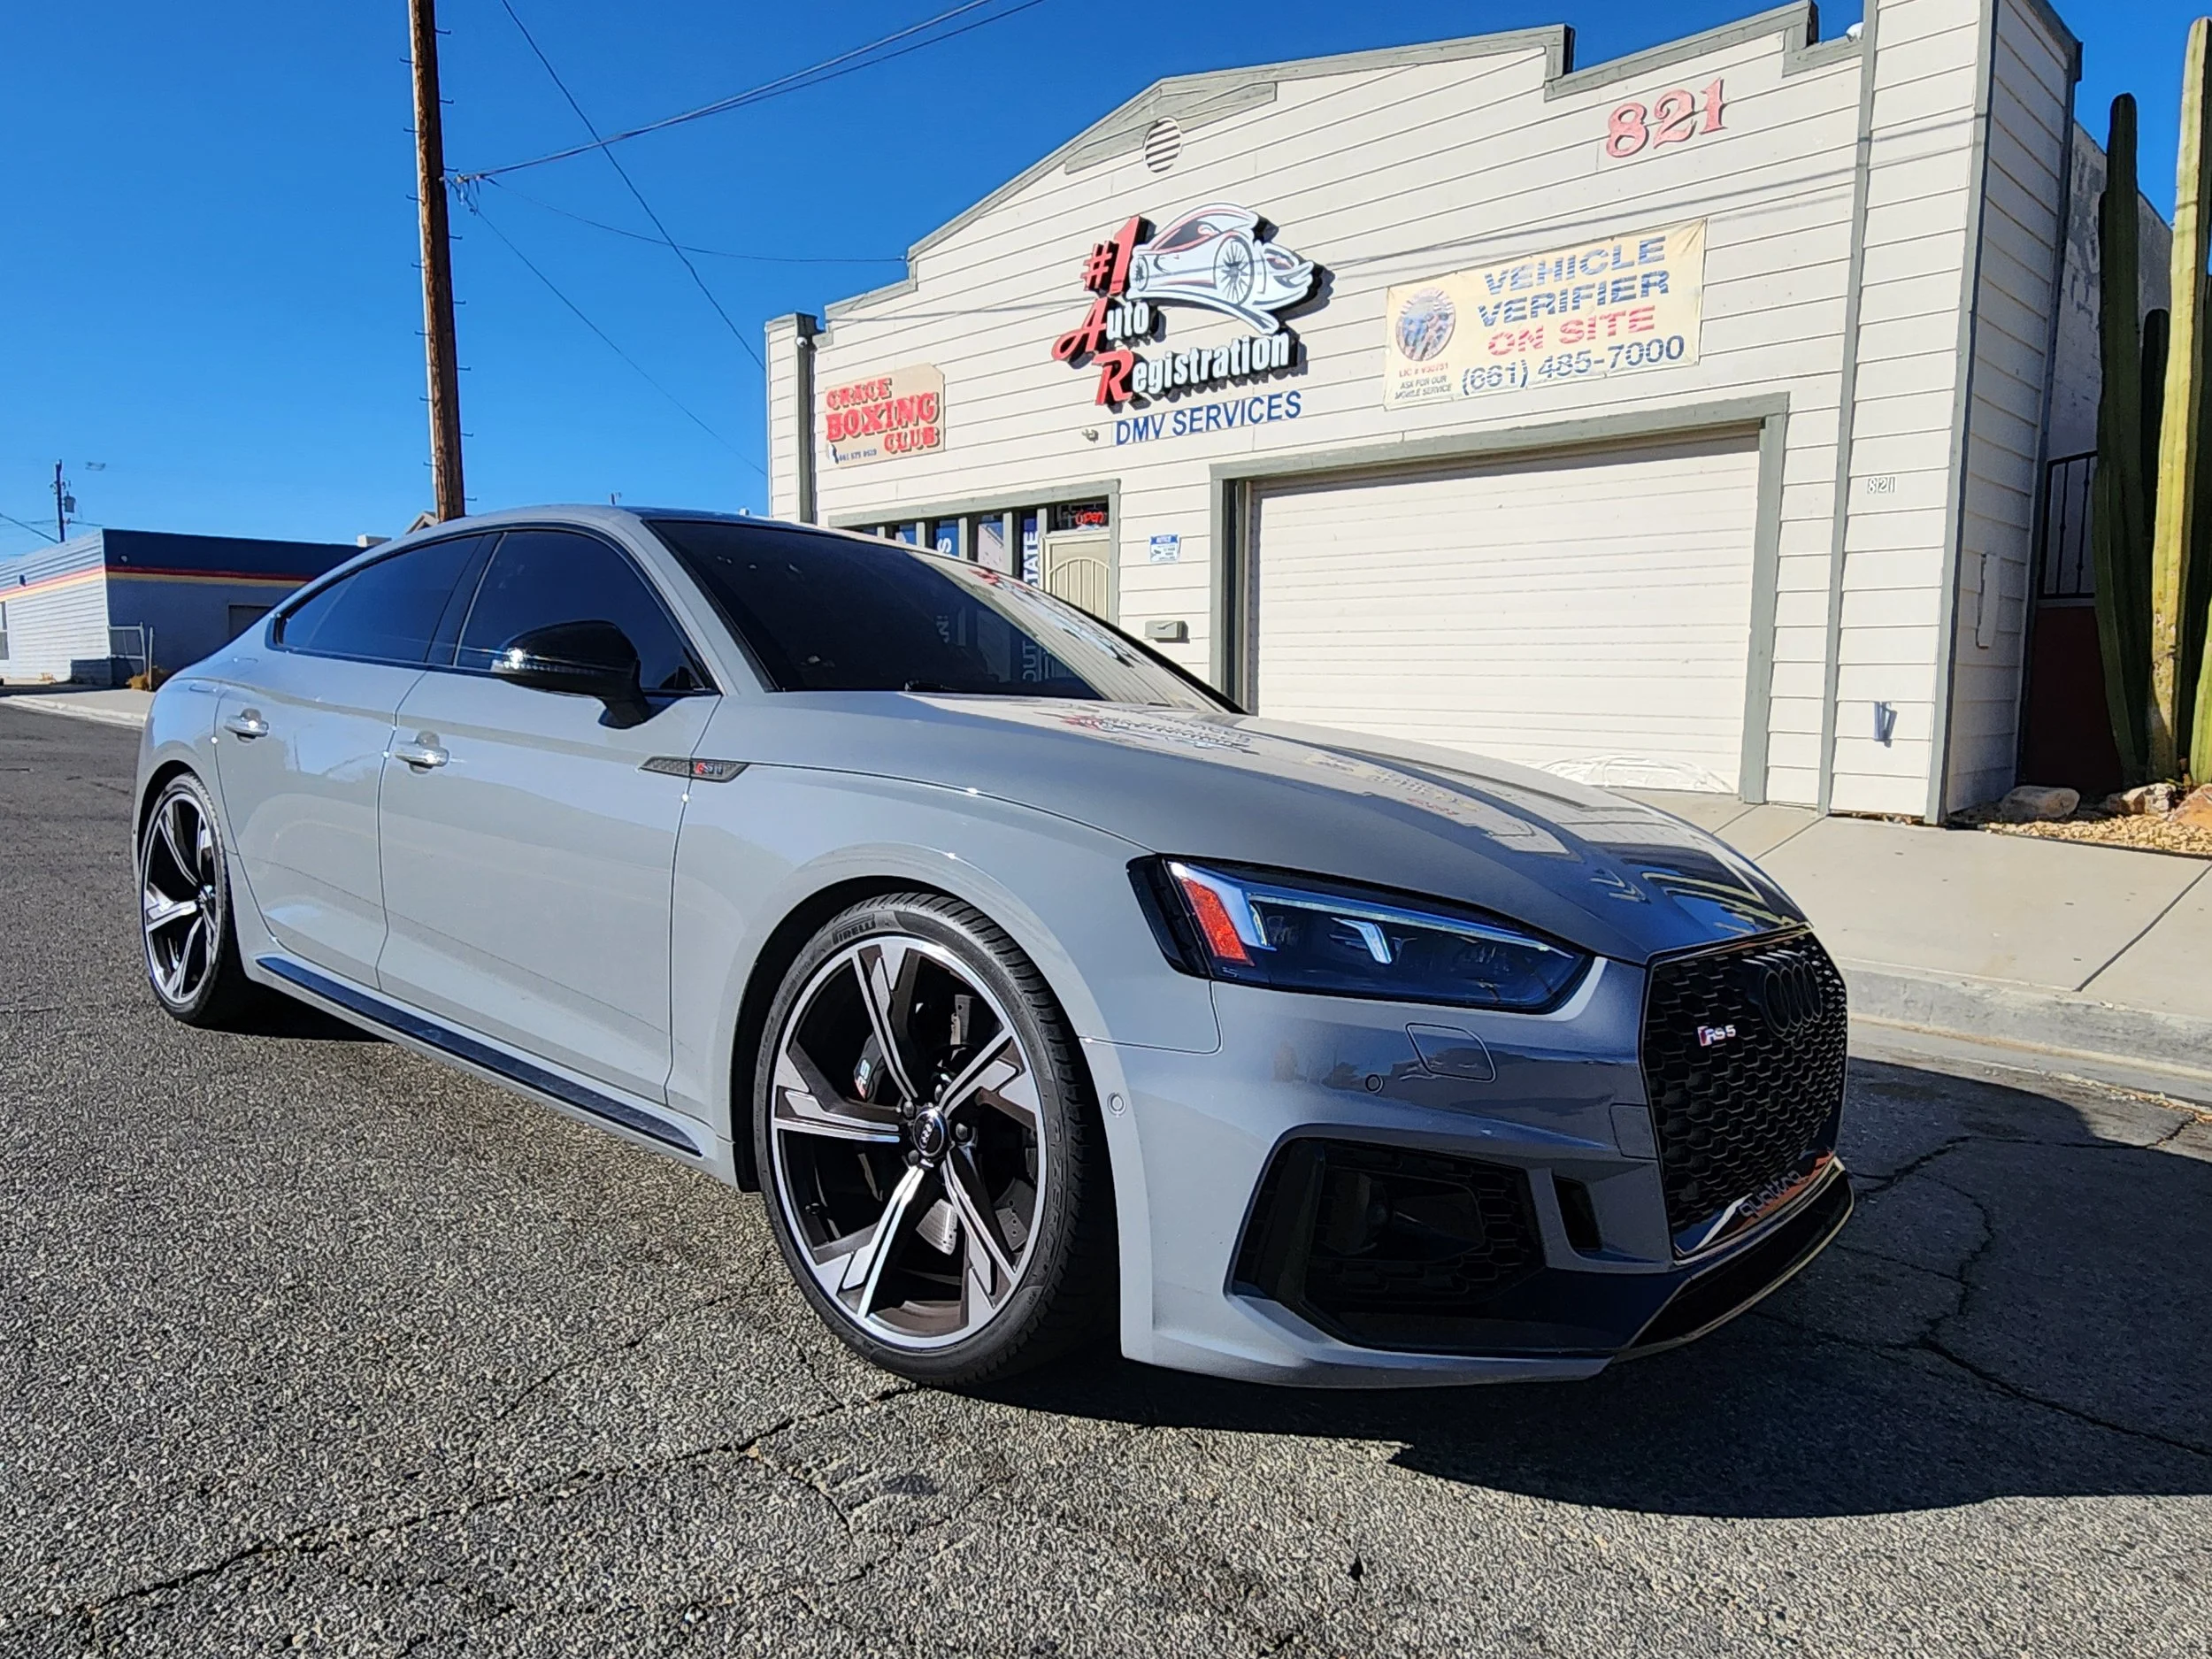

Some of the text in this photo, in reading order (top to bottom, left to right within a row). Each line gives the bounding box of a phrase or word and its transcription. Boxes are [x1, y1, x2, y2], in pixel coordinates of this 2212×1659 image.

[1606, 77, 1728, 158] 821
[1080, 215, 1140, 296] #1
[1485, 236, 1666, 295] VEHICLE
[1478, 270, 1670, 327] VERIFIER
[1051, 296, 1149, 361] Auto
[1488, 305, 1655, 356] ON SITE
[1092, 332, 1290, 404] Registration
[1423, 383, 1453, 396] SERVICE
[1462, 334, 1685, 396] (661) 485-7000
[826, 392, 940, 442] BOXING
[883, 426, 940, 454] CLUB
[1116, 390, 1302, 445] DMV SERVICES
[1868, 476, 1895, 495] 821
[1024, 532, 1039, 588] TATE
[832, 913, 876, 945] PIRELLI
[1739, 1170, 1801, 1217] quattro
